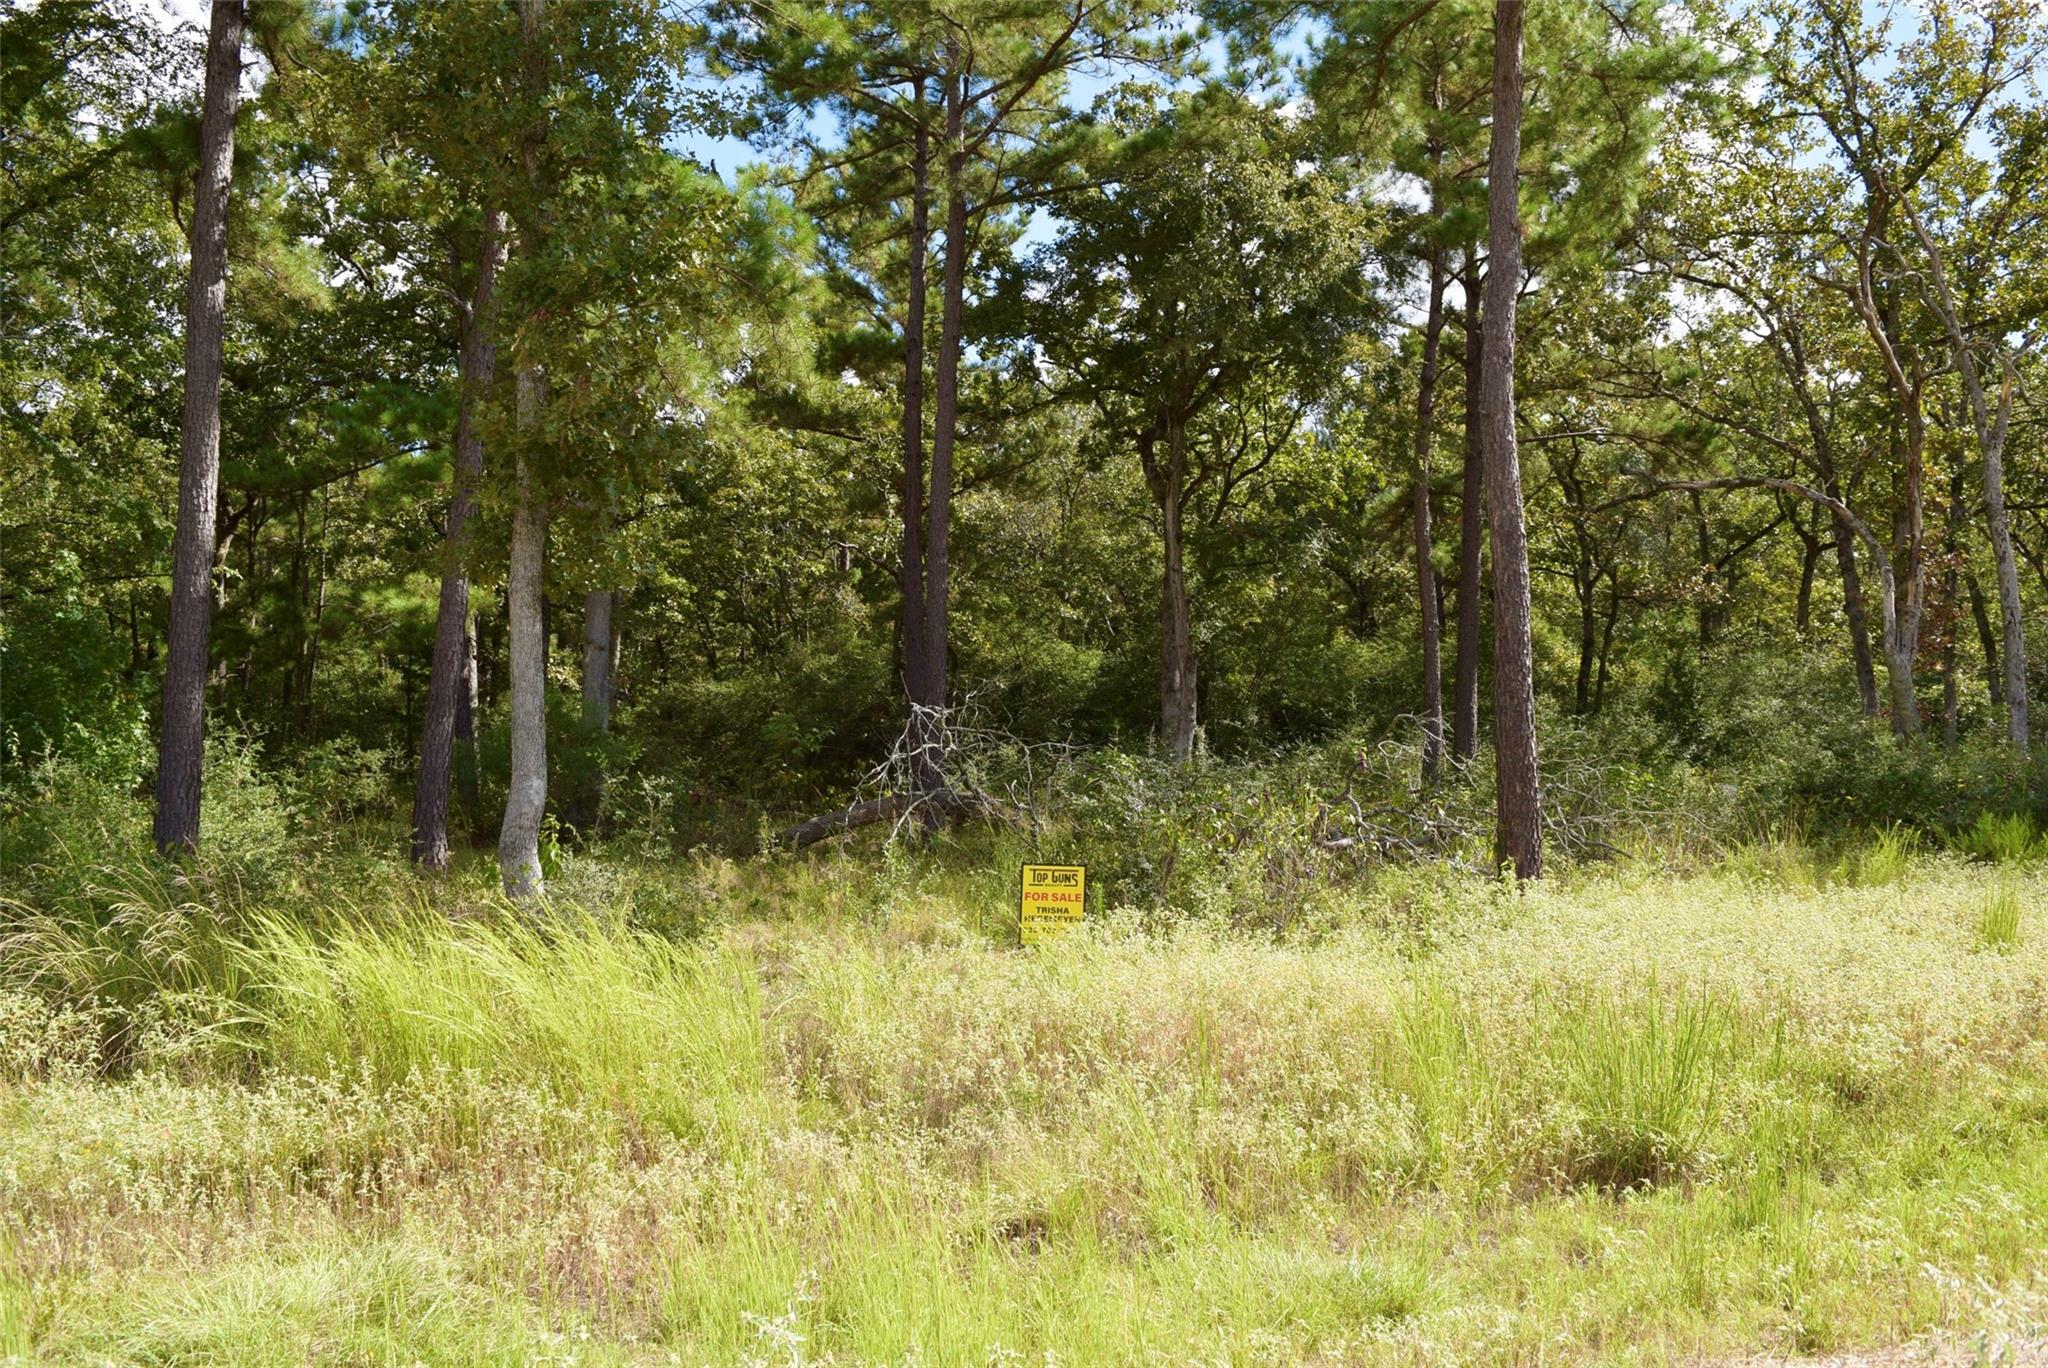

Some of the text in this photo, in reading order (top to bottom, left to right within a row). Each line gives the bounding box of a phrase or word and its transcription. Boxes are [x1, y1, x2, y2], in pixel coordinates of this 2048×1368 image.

[1029, 868, 1079, 887] TOP GUNS
[1024, 892, 1082, 902] FOR SALE
[1036, 906, 1069, 914] TRISHA
